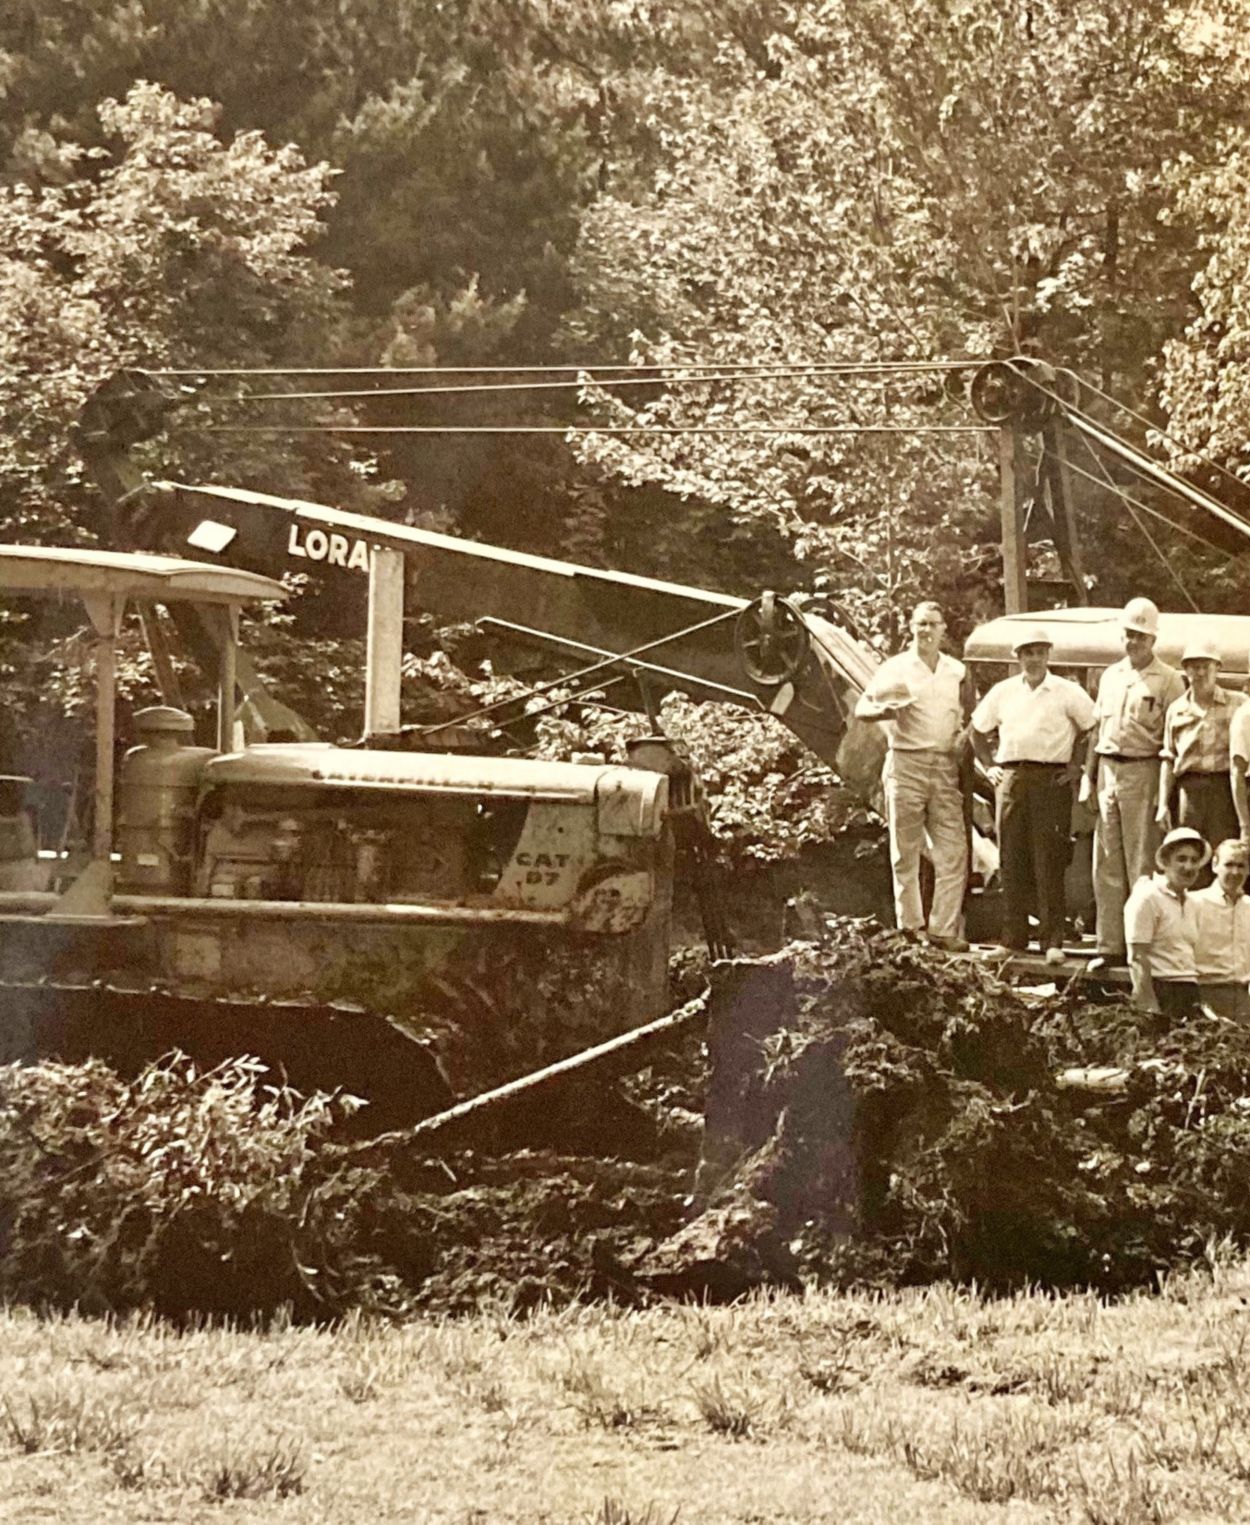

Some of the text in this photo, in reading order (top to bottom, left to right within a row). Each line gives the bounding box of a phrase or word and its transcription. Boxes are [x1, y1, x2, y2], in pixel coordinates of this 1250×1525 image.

[288, 524, 385, 573] LORA
[516, 852, 571, 868] CAT
[526, 871, 560, 886] D7
